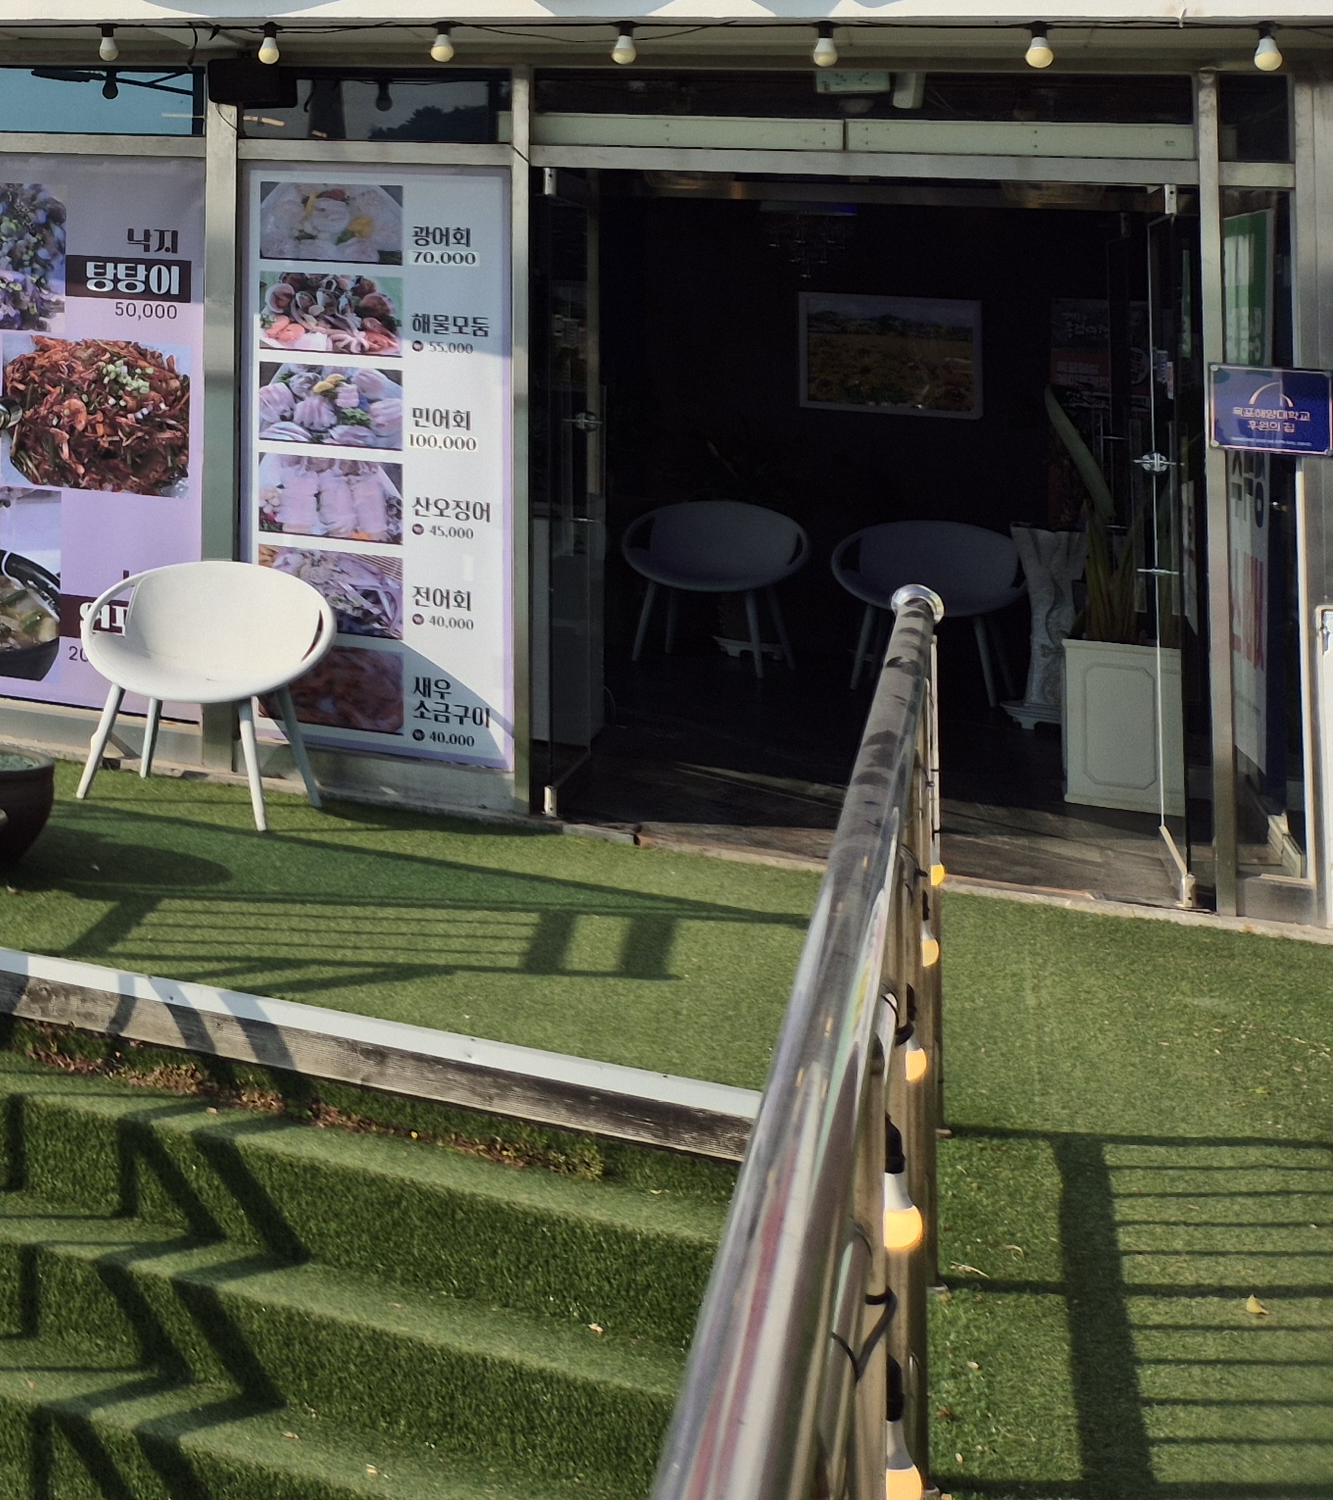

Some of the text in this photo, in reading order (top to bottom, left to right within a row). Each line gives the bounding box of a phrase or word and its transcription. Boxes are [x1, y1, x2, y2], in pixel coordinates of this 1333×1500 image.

[126, 227, 179, 254] 낙지
[411, 225, 471, 248] 광어회
[86, 260, 180, 296] 탕탕이
[114, 301, 178, 321] 50,000
[411, 407, 471, 431] 민어회
[411, 496, 492, 523] 산오징어
[411, 585, 472, 612] 전어회
[413, 675, 452, 700] 새우
[413, 701, 491, 729] 소금구이
